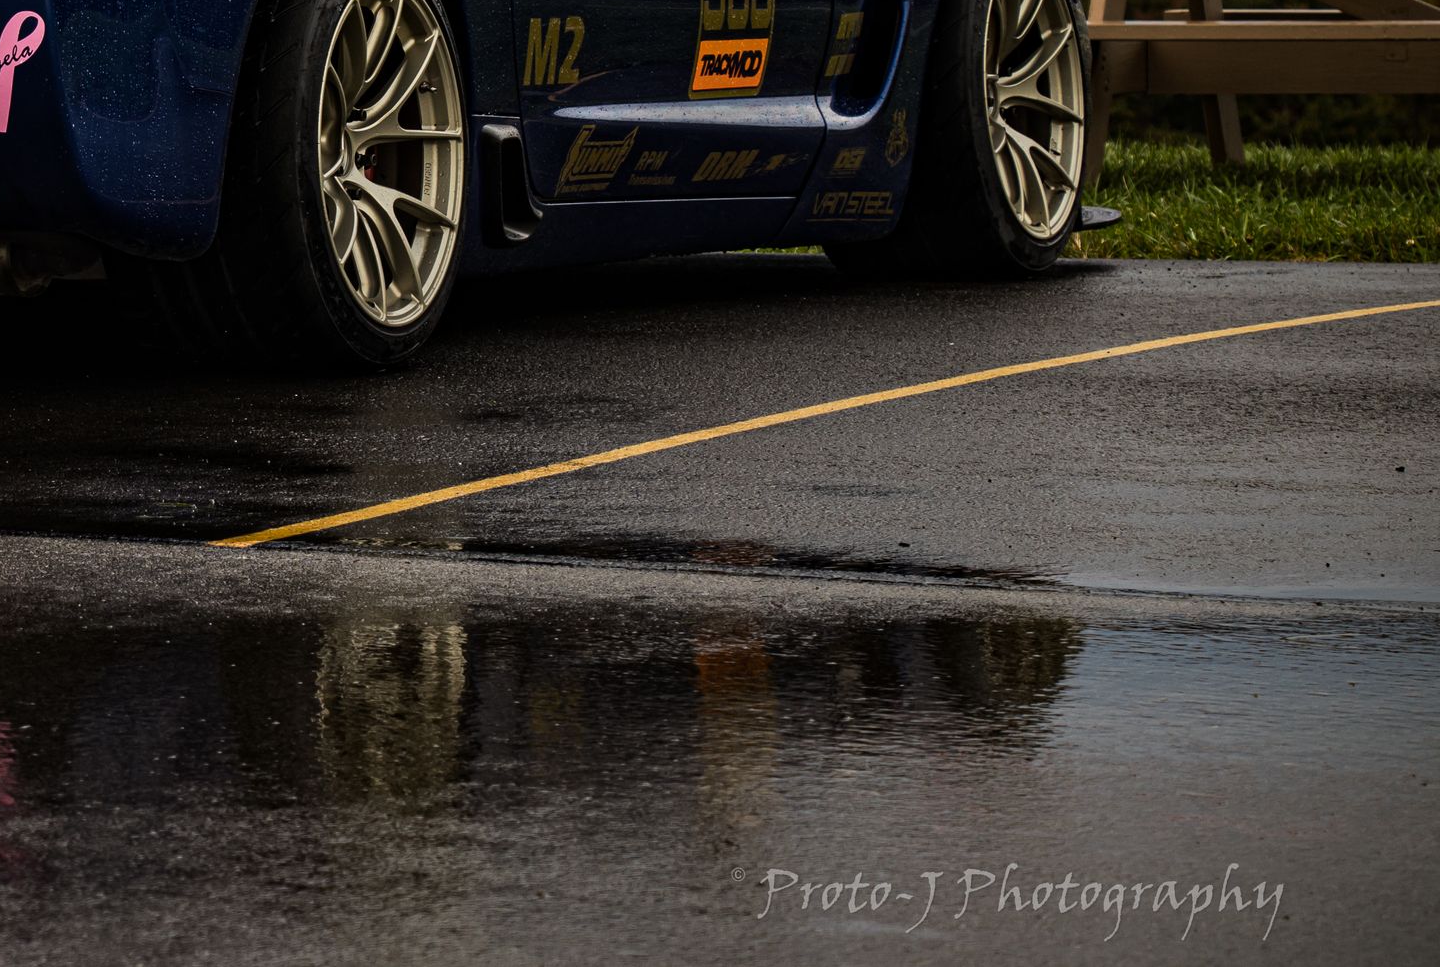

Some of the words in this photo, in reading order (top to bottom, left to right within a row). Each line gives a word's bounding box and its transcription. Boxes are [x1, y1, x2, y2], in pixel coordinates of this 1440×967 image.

[522, 16, 586, 87] M2
[700, 50, 763, 78] TRACKMOD
[633, 149, 670, 171] RPM
